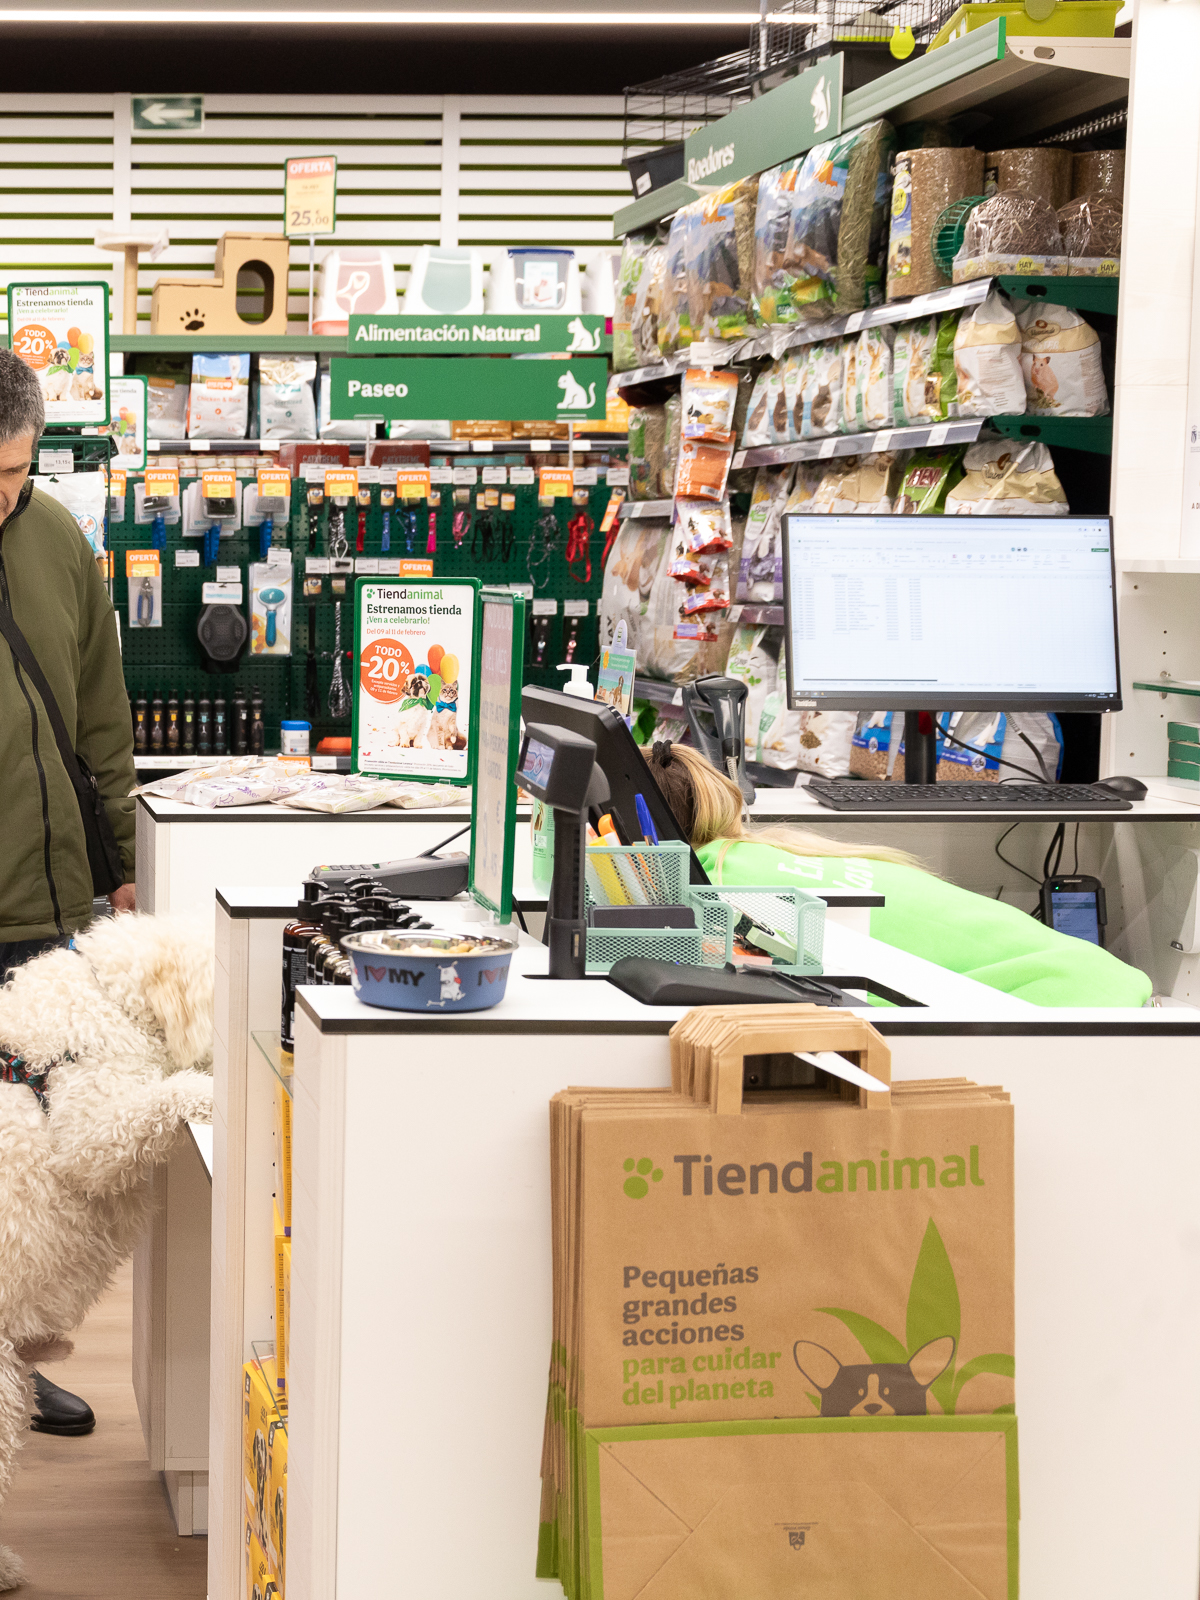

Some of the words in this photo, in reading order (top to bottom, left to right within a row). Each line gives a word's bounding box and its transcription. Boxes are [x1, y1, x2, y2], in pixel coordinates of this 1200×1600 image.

[290, 161, 332, 174] OFERTA
[1019, 260, 1033, 268] HAY
[1100, 264, 1115, 272] HAY
[25, 287, 79, 296] Tiendanimal
[16, 299, 66, 307] Estrenamos
[24, 328, 46, 338] TODO
[355, 323, 470, 343] Alimentación
[472, 323, 541, 343] Natural
[13, 336, 53, 355] -20%
[348, 379, 408, 399] Paseo
[197, 395, 221, 403] Chicken
[147, 473, 177, 481] OFERTA
[204, 474, 233, 482] OFERTA
[261, 473, 290, 481] OFERTA
[326, 473, 356, 481] OFERTA
[398, 474, 428, 482] OFERTA
[542, 473, 572, 481] OFERTA
[129, 553, 159, 562] OFERTA
[402, 563, 432, 572] OFERTA
[377, 588, 444, 600] Tiendanimal
[366, 603, 427, 615] Estrenamos
[429, 604, 462, 615] tienda
[366, 616, 383, 624] ¡Ven
[389, 616, 430, 625] celebrarlo!
[375, 645, 402, 658] TODO
[360, 655, 410, 681] -20%
[363, 964, 370, 981] I
[388, 967, 426, 987] MY
[673, 1144, 985, 1197] Tiendanimal
[622, 1262, 759, 1294] Pequeñas
[622, 1292, 738, 1324] grandes
[622, 1318, 745, 1347] acciones
[622, 1355, 688, 1383] para
[692, 1346, 782, 1375] cuidar
[622, 1380, 664, 1406] del
[669, 1377, 775, 1409] planeta
